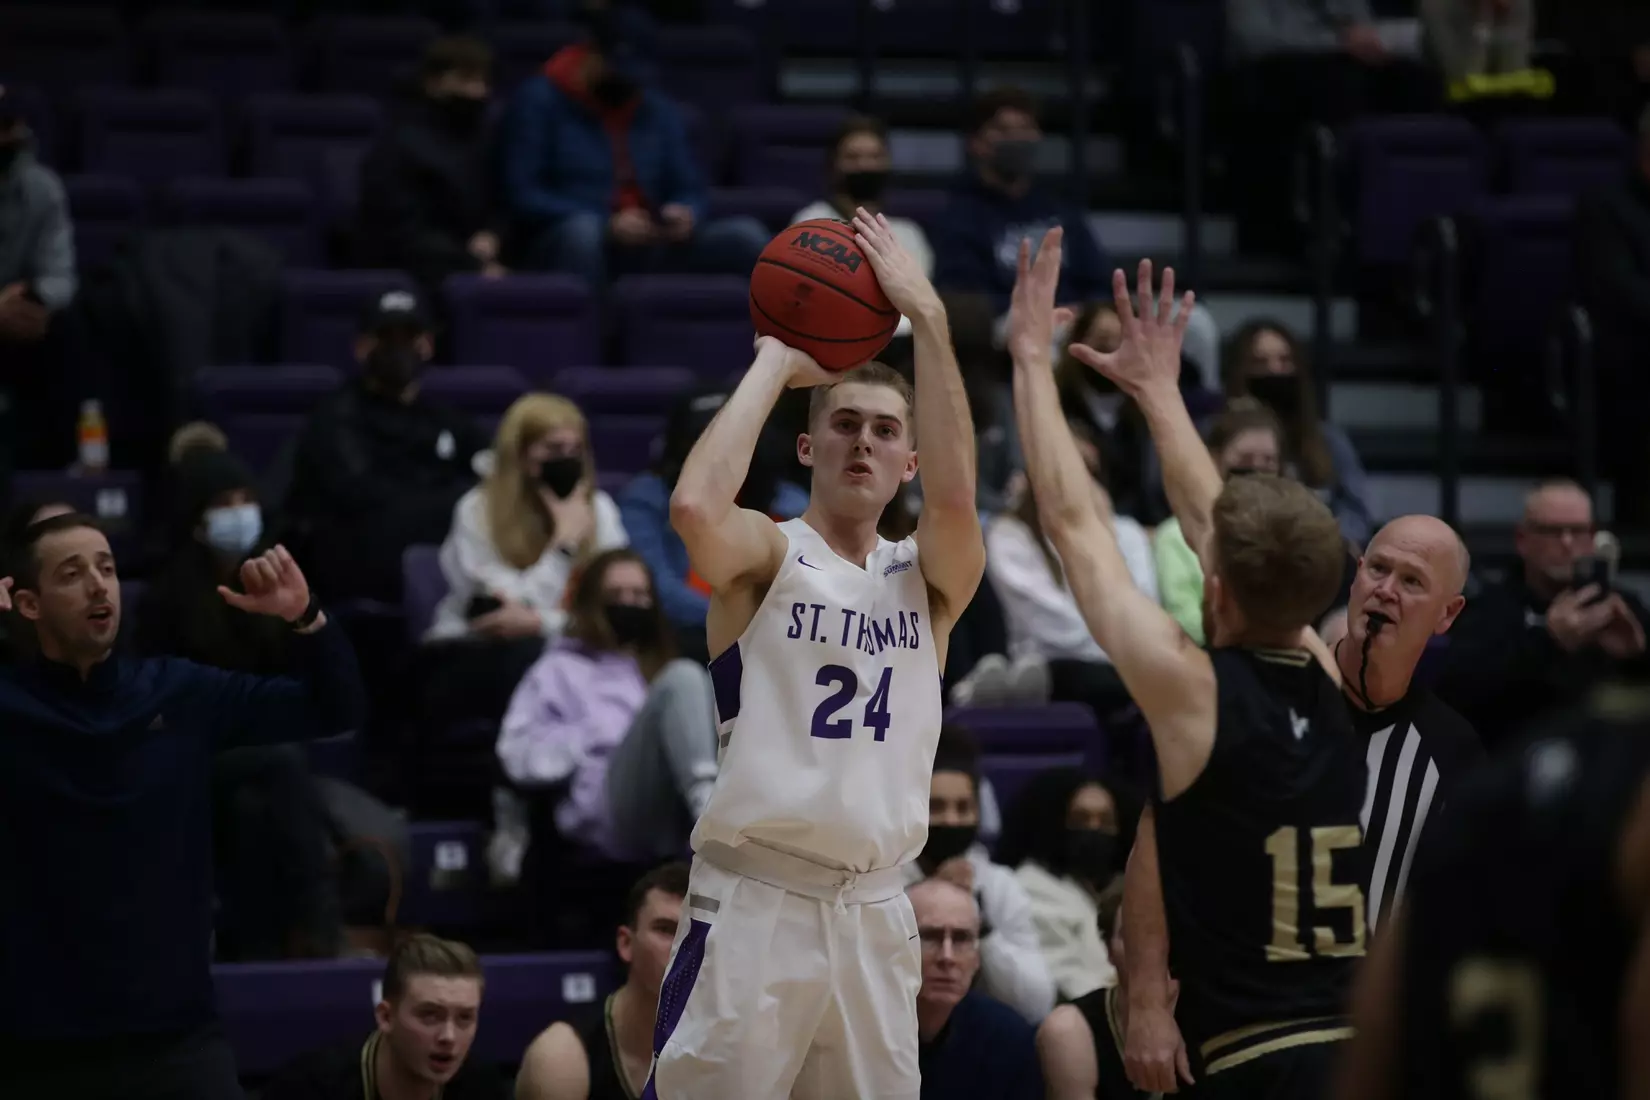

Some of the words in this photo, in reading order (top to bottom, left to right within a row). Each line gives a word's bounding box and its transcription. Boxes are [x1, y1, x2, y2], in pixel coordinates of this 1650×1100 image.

[790, 231, 863, 273] NCAA
[787, 602, 827, 643] ST.
[810, 664, 893, 742] 24
[1262, 824, 1367, 963] 15
